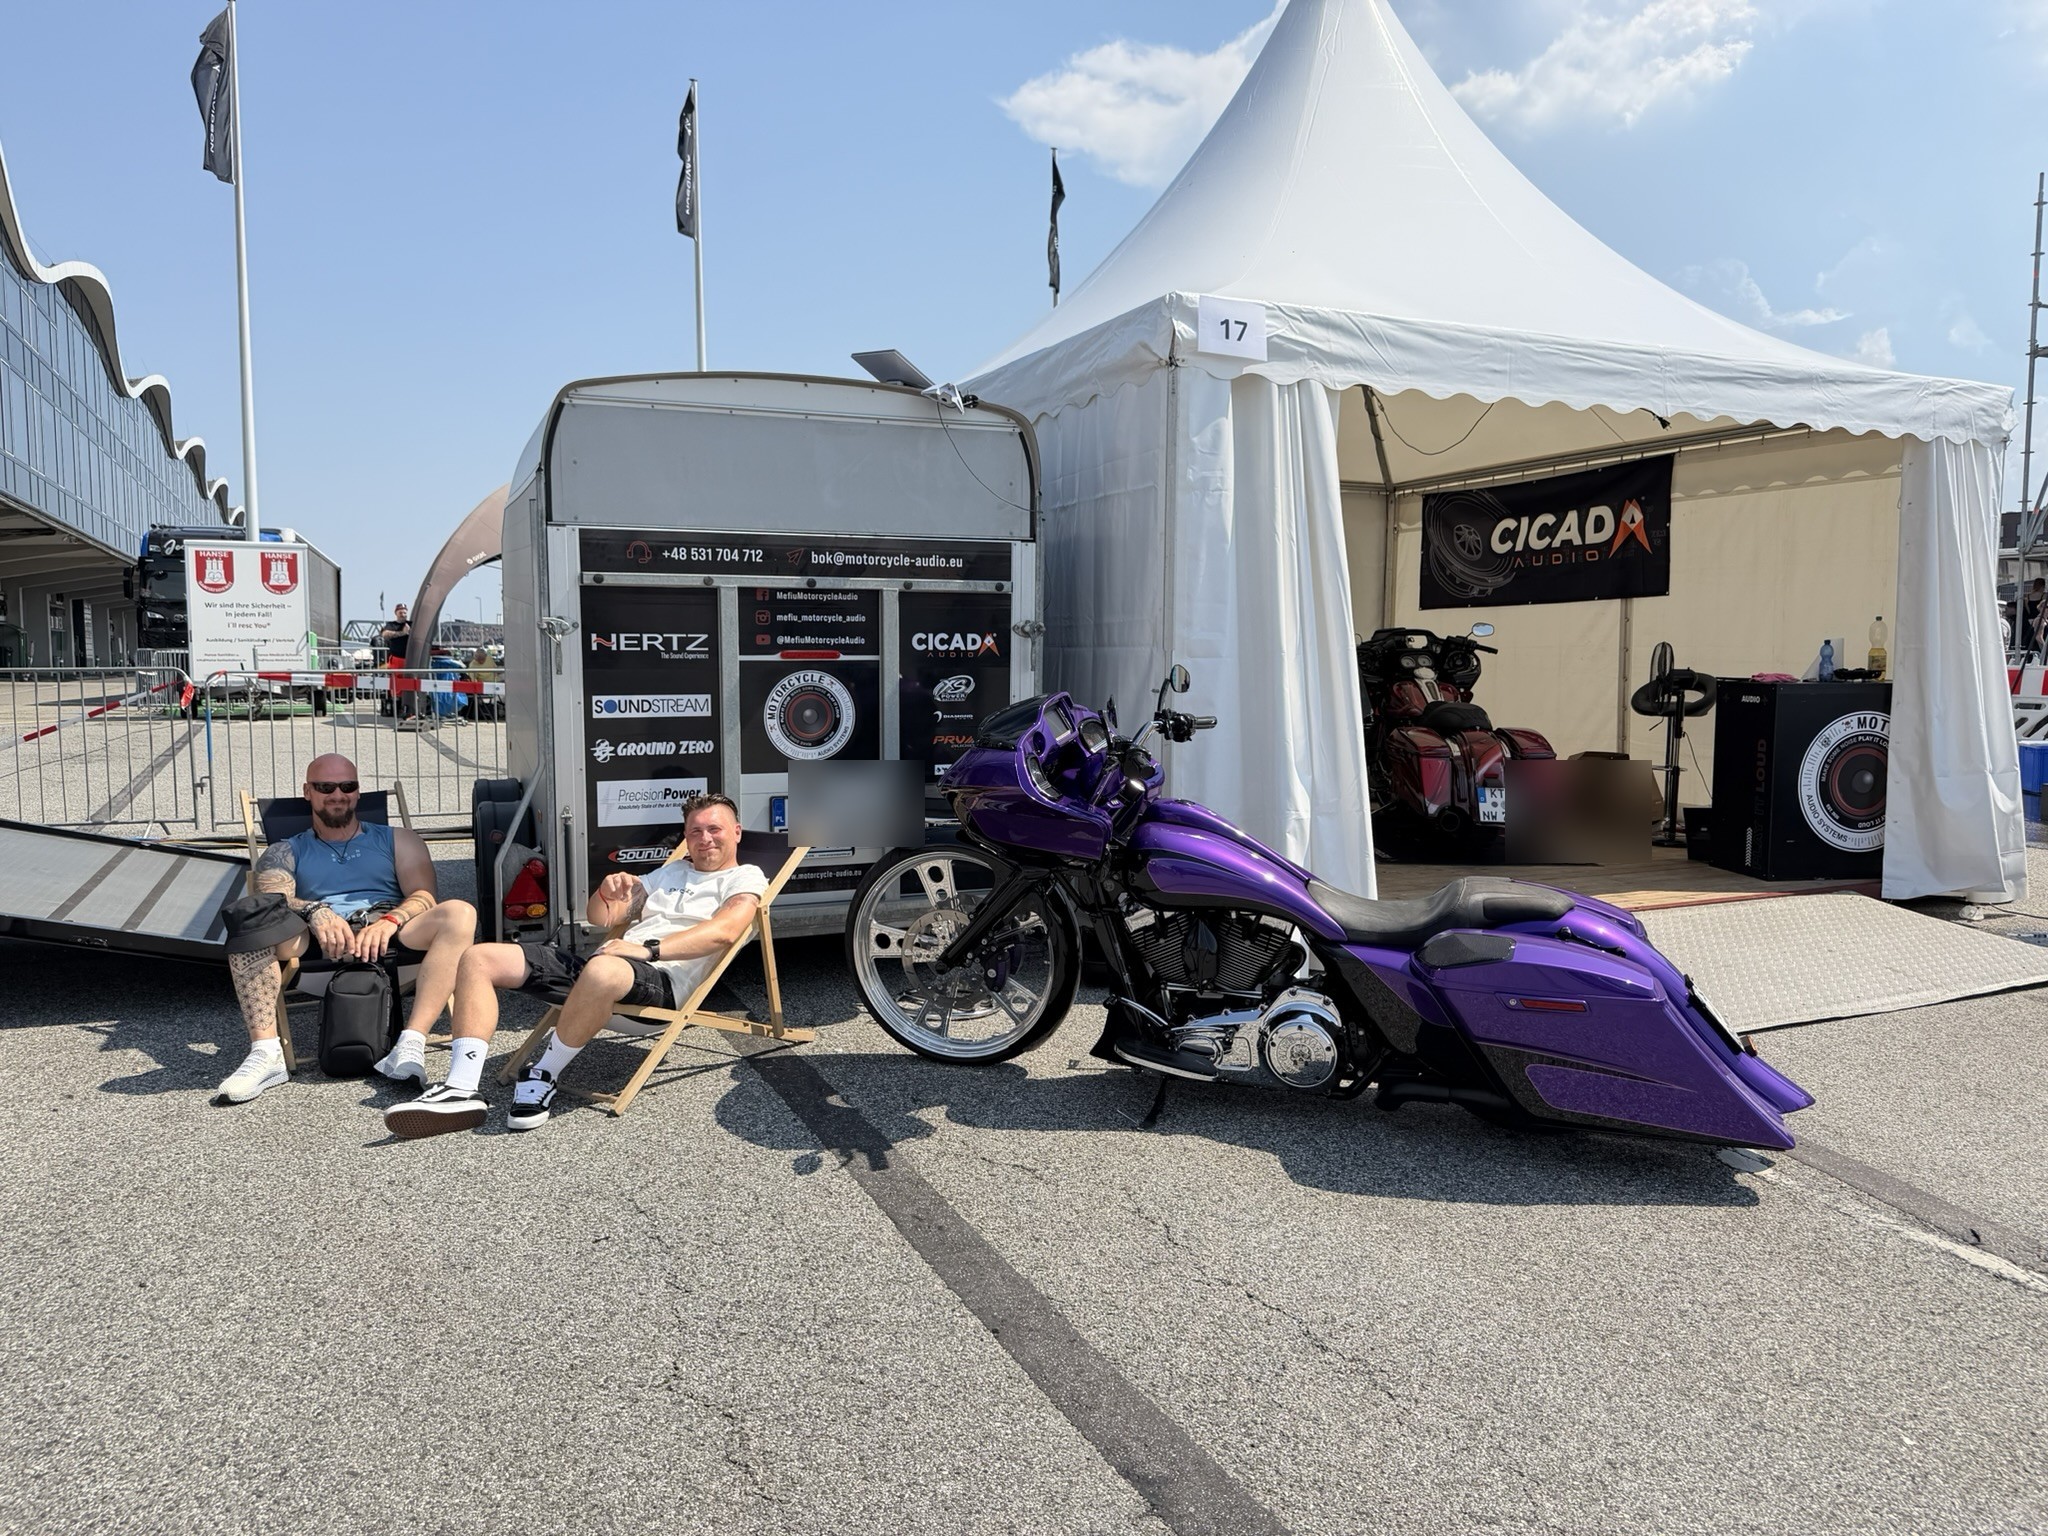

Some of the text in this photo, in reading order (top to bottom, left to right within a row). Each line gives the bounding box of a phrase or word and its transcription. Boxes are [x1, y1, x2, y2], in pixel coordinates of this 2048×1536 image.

[1220, 318, 1247, 341] 17
[1490, 499, 1653, 559] CICADA
[662, 547, 763, 562] +48 531 704 712
[811, 551, 963, 568] bok@motorcycle-audio.eu
[1514, 549, 1600, 568] AUDIO
[776, 592, 858, 601] MefiuMotorcycleAudio
[776, 613, 866, 623] mefiu_motorcycle_audio
[590, 633, 709, 651] HERTZ
[776, 635, 866, 646] @MefiuMotorcycleAudio
[912, 632, 1000, 657] CICADA
[767, 673, 826, 720] MOTORCYCLE
[1741, 695, 1760, 703] AUDIO
[594, 698, 710, 714] SOUNDSTREAM
[1857, 716, 1890, 732] MOT
[617, 740, 714, 756] GROUND ZERO
[1755, 739, 1767, 793] LOUD
[618, 787, 702, 802] PrecisionPower
[1806, 794, 1819, 819] AUDIO
[1818, 818, 1848, 843] SYSTEMS
[789, 869, 862, 880] w.motorcycle-audio.eu
